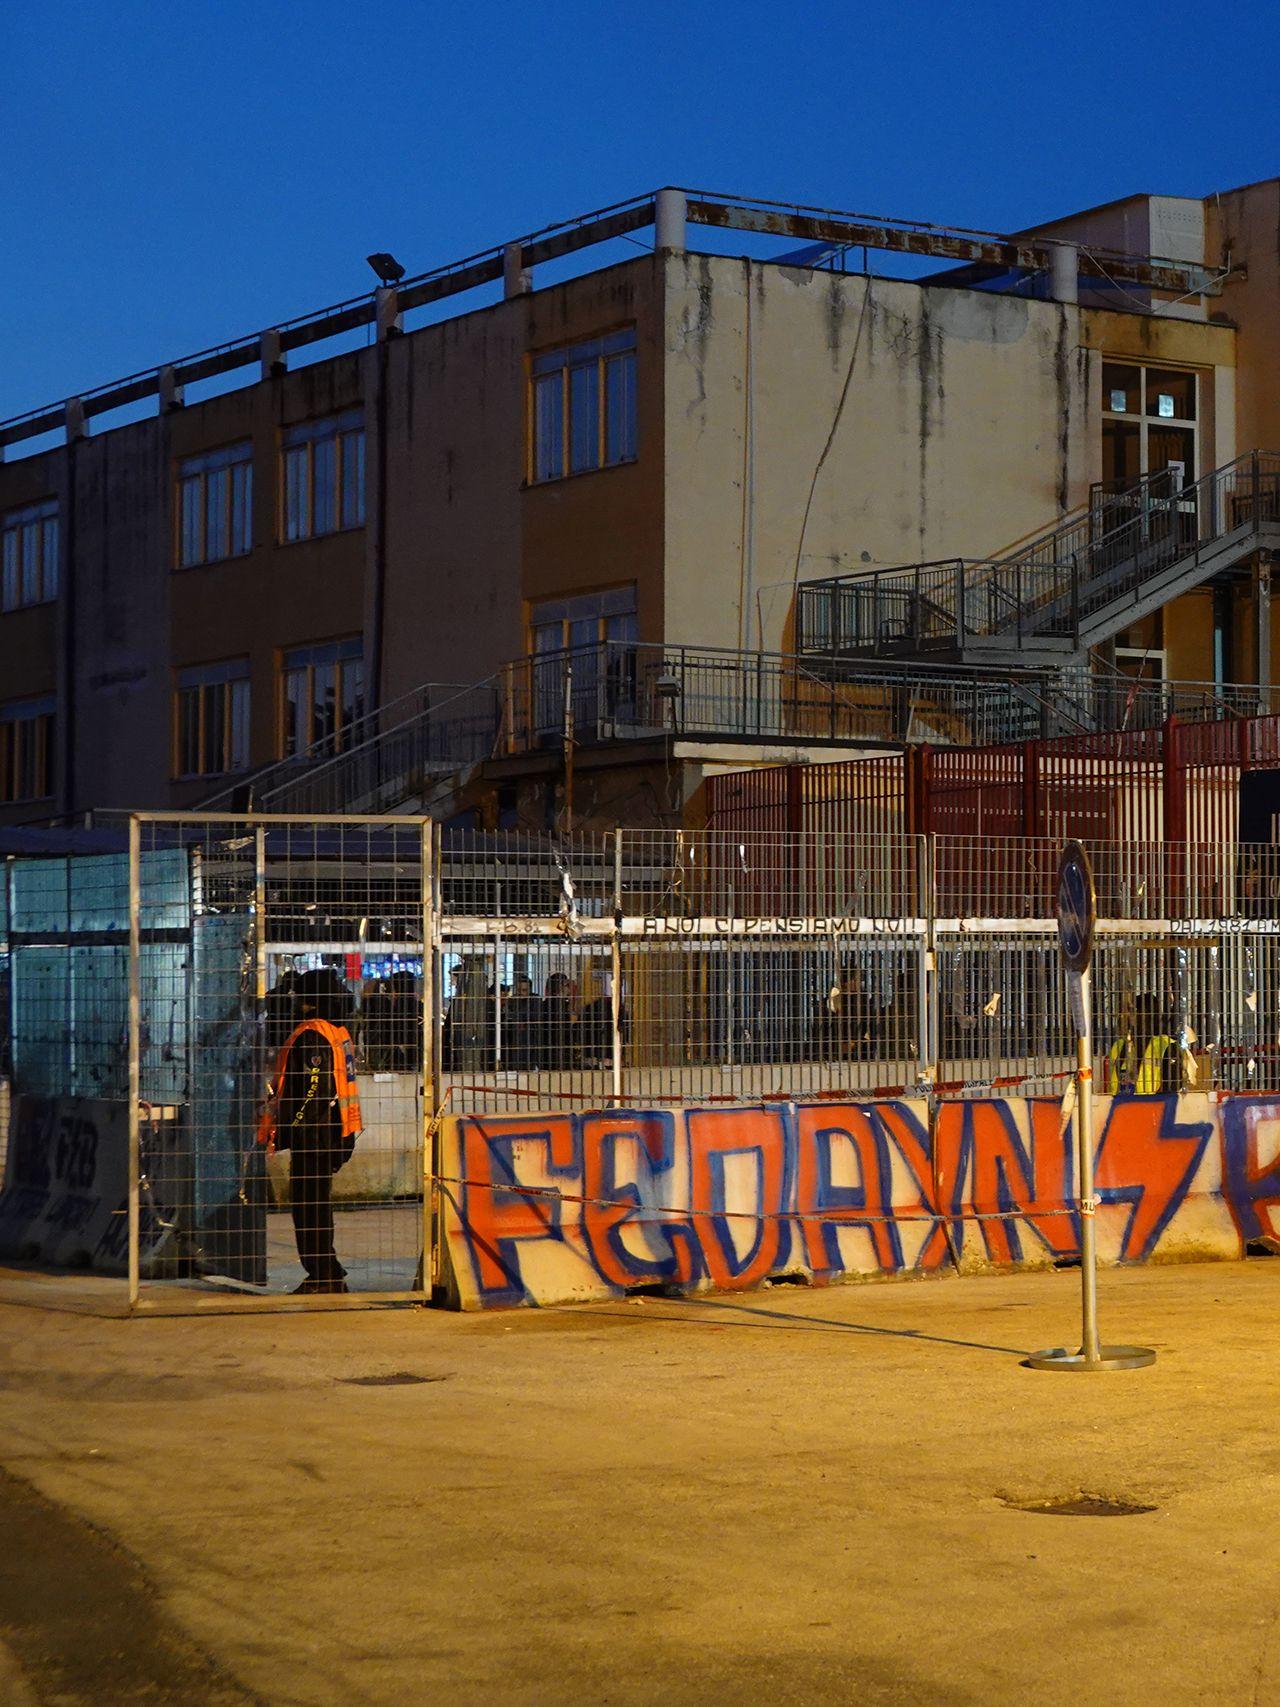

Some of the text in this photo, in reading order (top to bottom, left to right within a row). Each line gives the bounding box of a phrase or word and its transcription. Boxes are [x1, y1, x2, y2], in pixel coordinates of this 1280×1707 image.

[643, 917, 657, 934] A
[665, 917, 701, 934] NOI
[715, 917, 734, 934] CI
[744, 917, 860, 934] PENSIAMO
[1170, 919, 1203, 933] DAL
[1208, 919, 1251, 933] 1981
[1256, 919, 1267, 933] A
